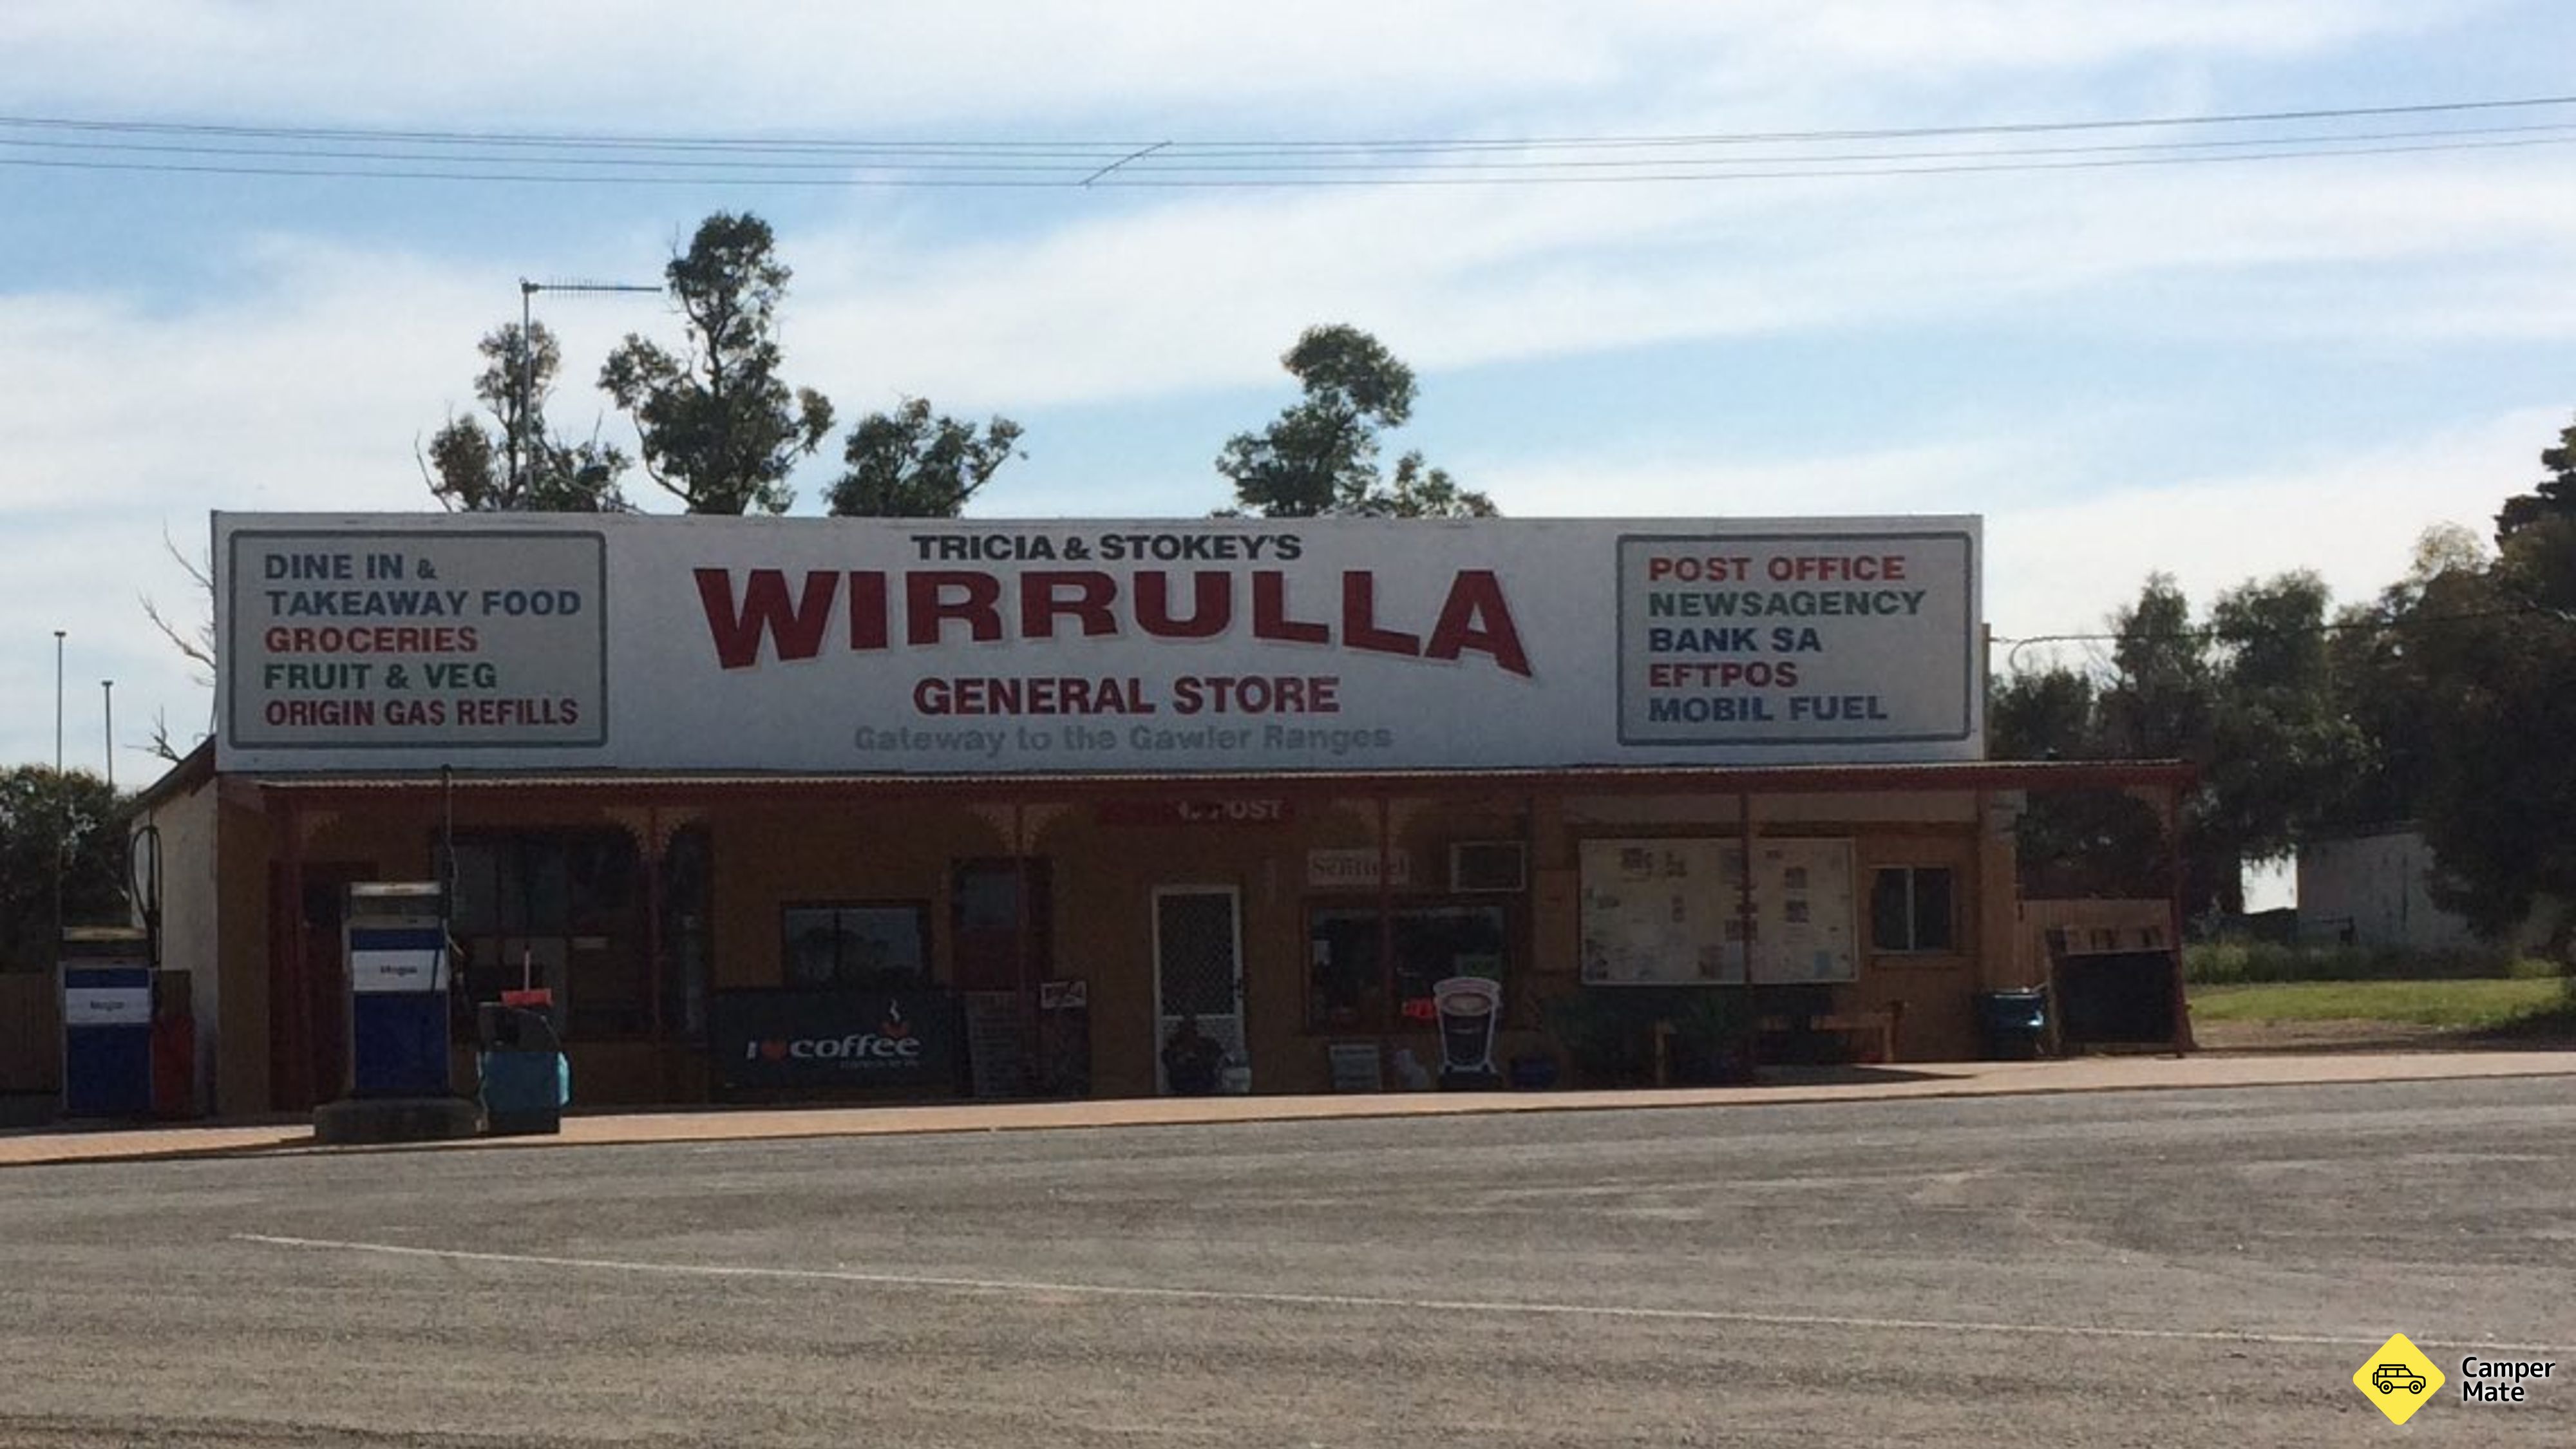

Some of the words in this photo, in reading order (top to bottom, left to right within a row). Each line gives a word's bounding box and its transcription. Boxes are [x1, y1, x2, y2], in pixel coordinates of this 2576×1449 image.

[911, 535, 1054, 560] TRICIA
[1063, 536, 1091, 560] &
[1100, 534, 1302, 560] STOKEY'S
[265, 554, 352, 579] DINE
[367, 554, 403, 579] IN
[417, 559, 438, 579] &
[1649, 557, 1752, 581] POST
[1768, 556, 1906, 581] OFFICE
[265, 591, 469, 616] TAKEAWAY
[482, 591, 582, 616] FOOD
[1649, 590, 1926, 618] NEWSAGENCY
[693, 568, 1533, 677] WIRRULLA
[265, 627, 478, 653] GROCERIES
[1649, 627, 1758, 653] BANK
[1772, 627, 1822, 652] SA
[265, 663, 372, 690] FRUIT
[386, 663, 410, 689] &
[424, 663, 497, 689] VEG
[1649, 661, 1798, 688] EFTPOS
[913, 677, 1155, 715] GENERAL
[1173, 677, 1340, 714] STORE
[1649, 696, 1774, 723] MOBIL
[1790, 696, 1888, 720] FUEL
[265, 700, 374, 726] ORIGIN
[385, 700, 446, 726] GAS
[457, 699, 578, 725] REFILLS
[855, 726, 1005, 757] Gateway
[1017, 728, 1052, 751] to
[1063, 726, 1117, 751] the
[1130, 724, 1251, 752] Gawler
[1264, 724, 1392, 755] Ranges
[790, 1034, 921, 1057] coffee
